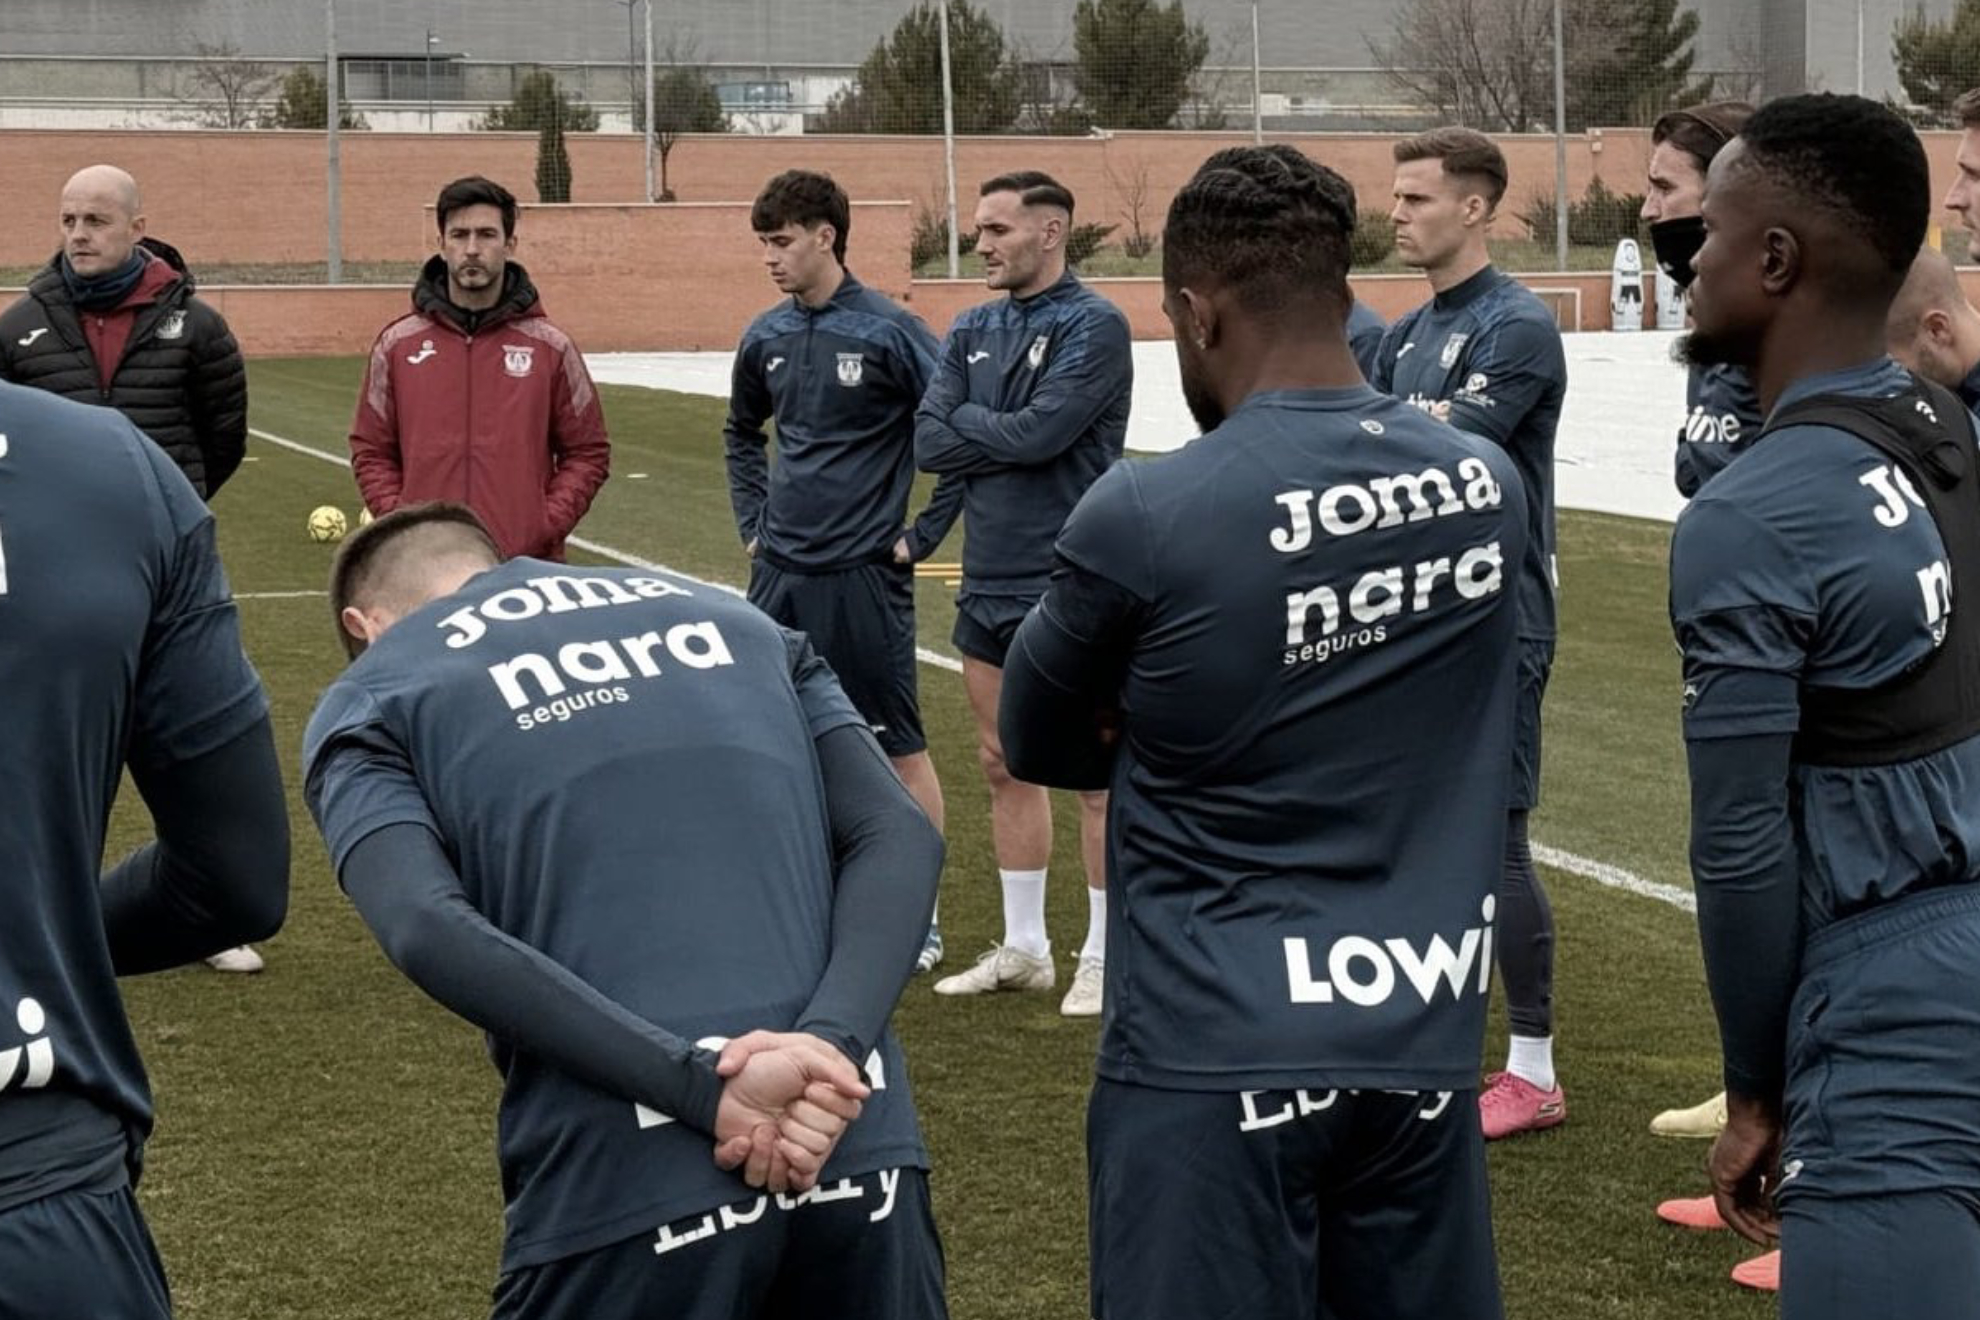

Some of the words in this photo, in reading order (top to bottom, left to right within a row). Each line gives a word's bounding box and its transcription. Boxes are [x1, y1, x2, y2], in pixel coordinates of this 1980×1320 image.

[1269, 457, 1502, 553] Joma
[436, 576, 694, 649] Joma
[1286, 541, 1504, 645] nara
[487, 620, 735, 710] nara
[1283, 624, 1388, 666] seguros
[516, 686, 630, 731] seguros
